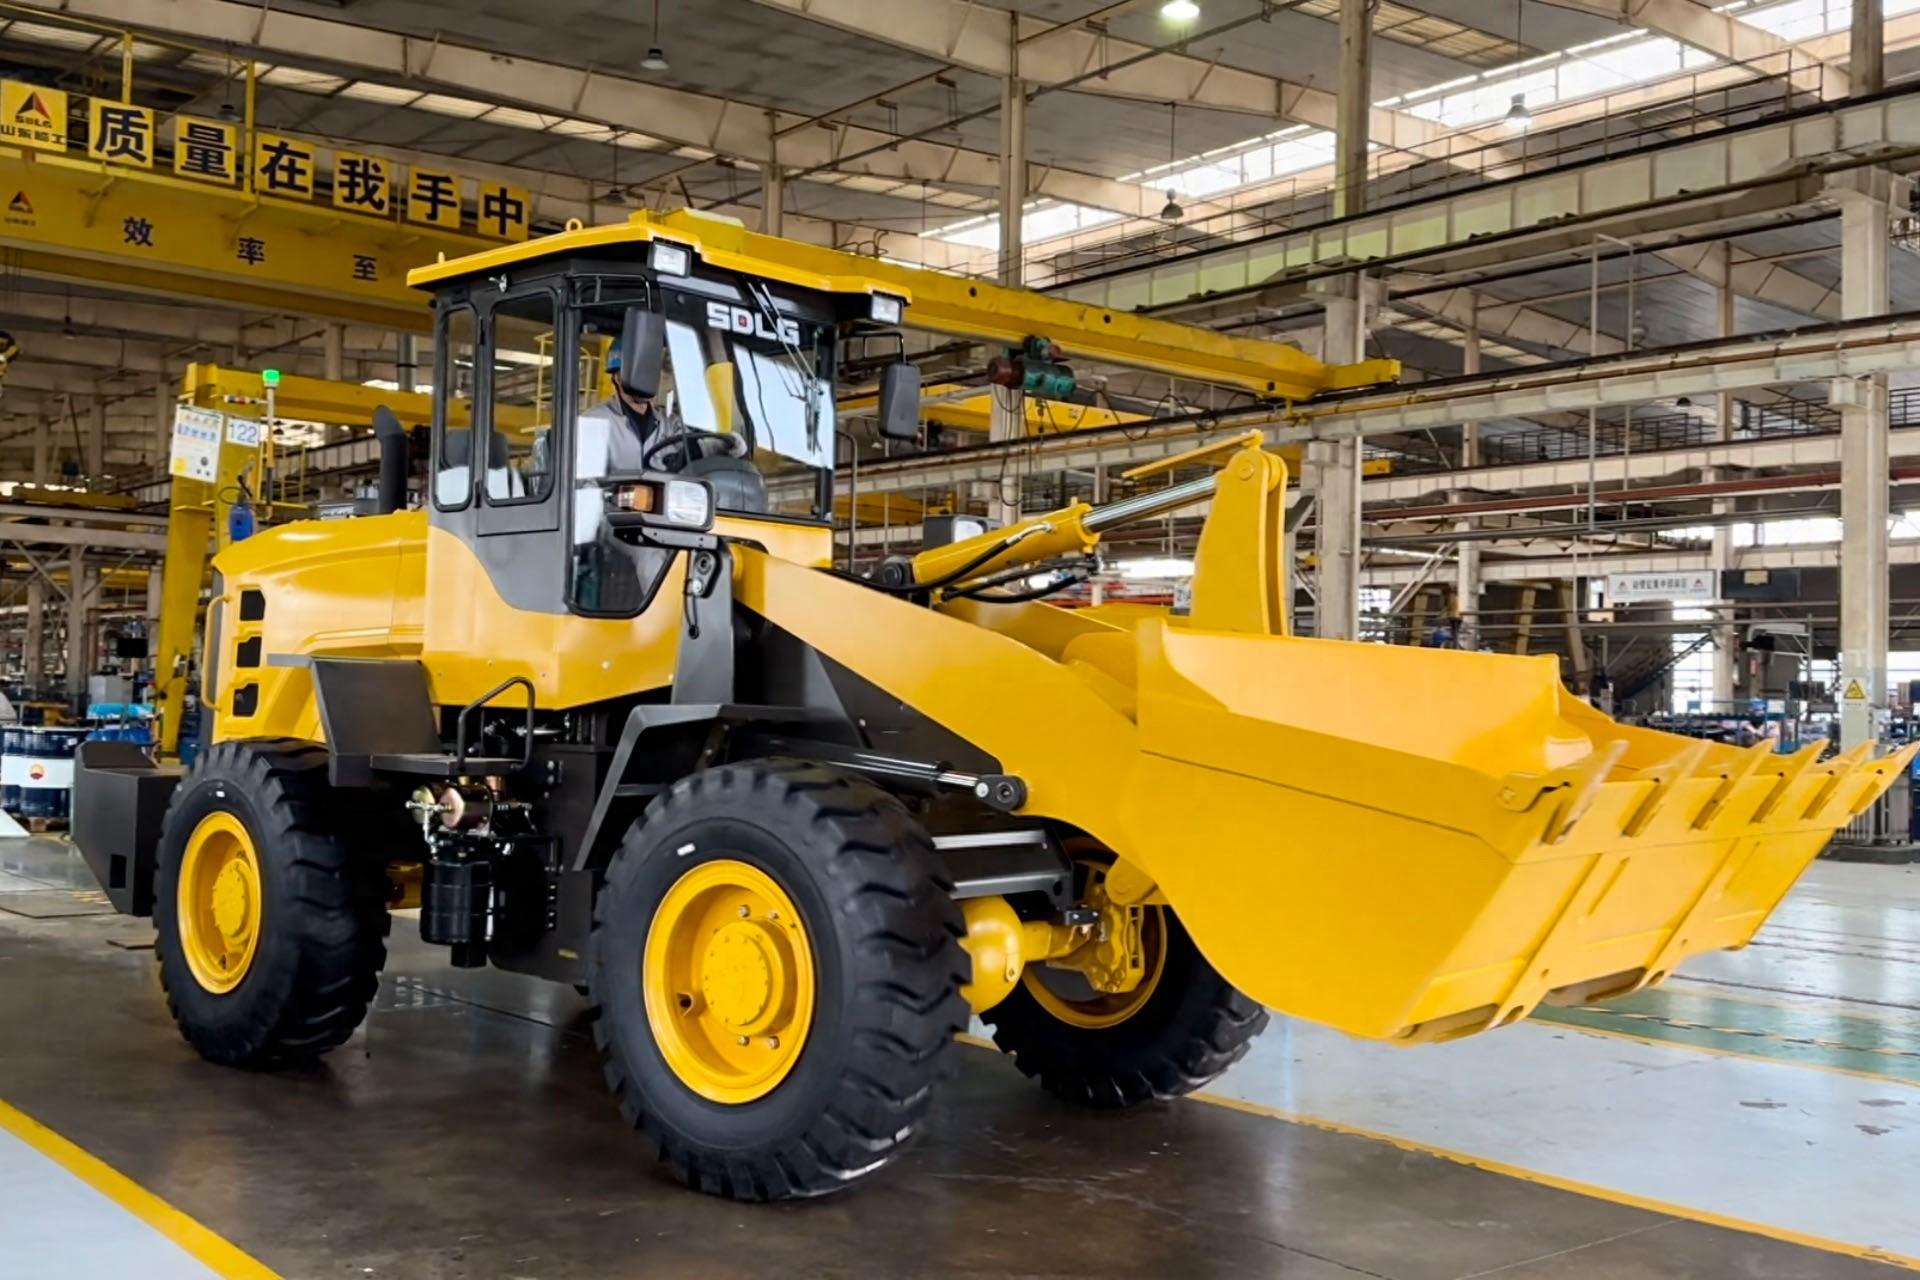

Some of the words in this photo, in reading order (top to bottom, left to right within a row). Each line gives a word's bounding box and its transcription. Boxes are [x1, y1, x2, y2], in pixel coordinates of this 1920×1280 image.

[94, 106, 525, 236] 质量在我手中
[706, 301, 800, 346] SDLG
[229, 423, 258, 443] 122
